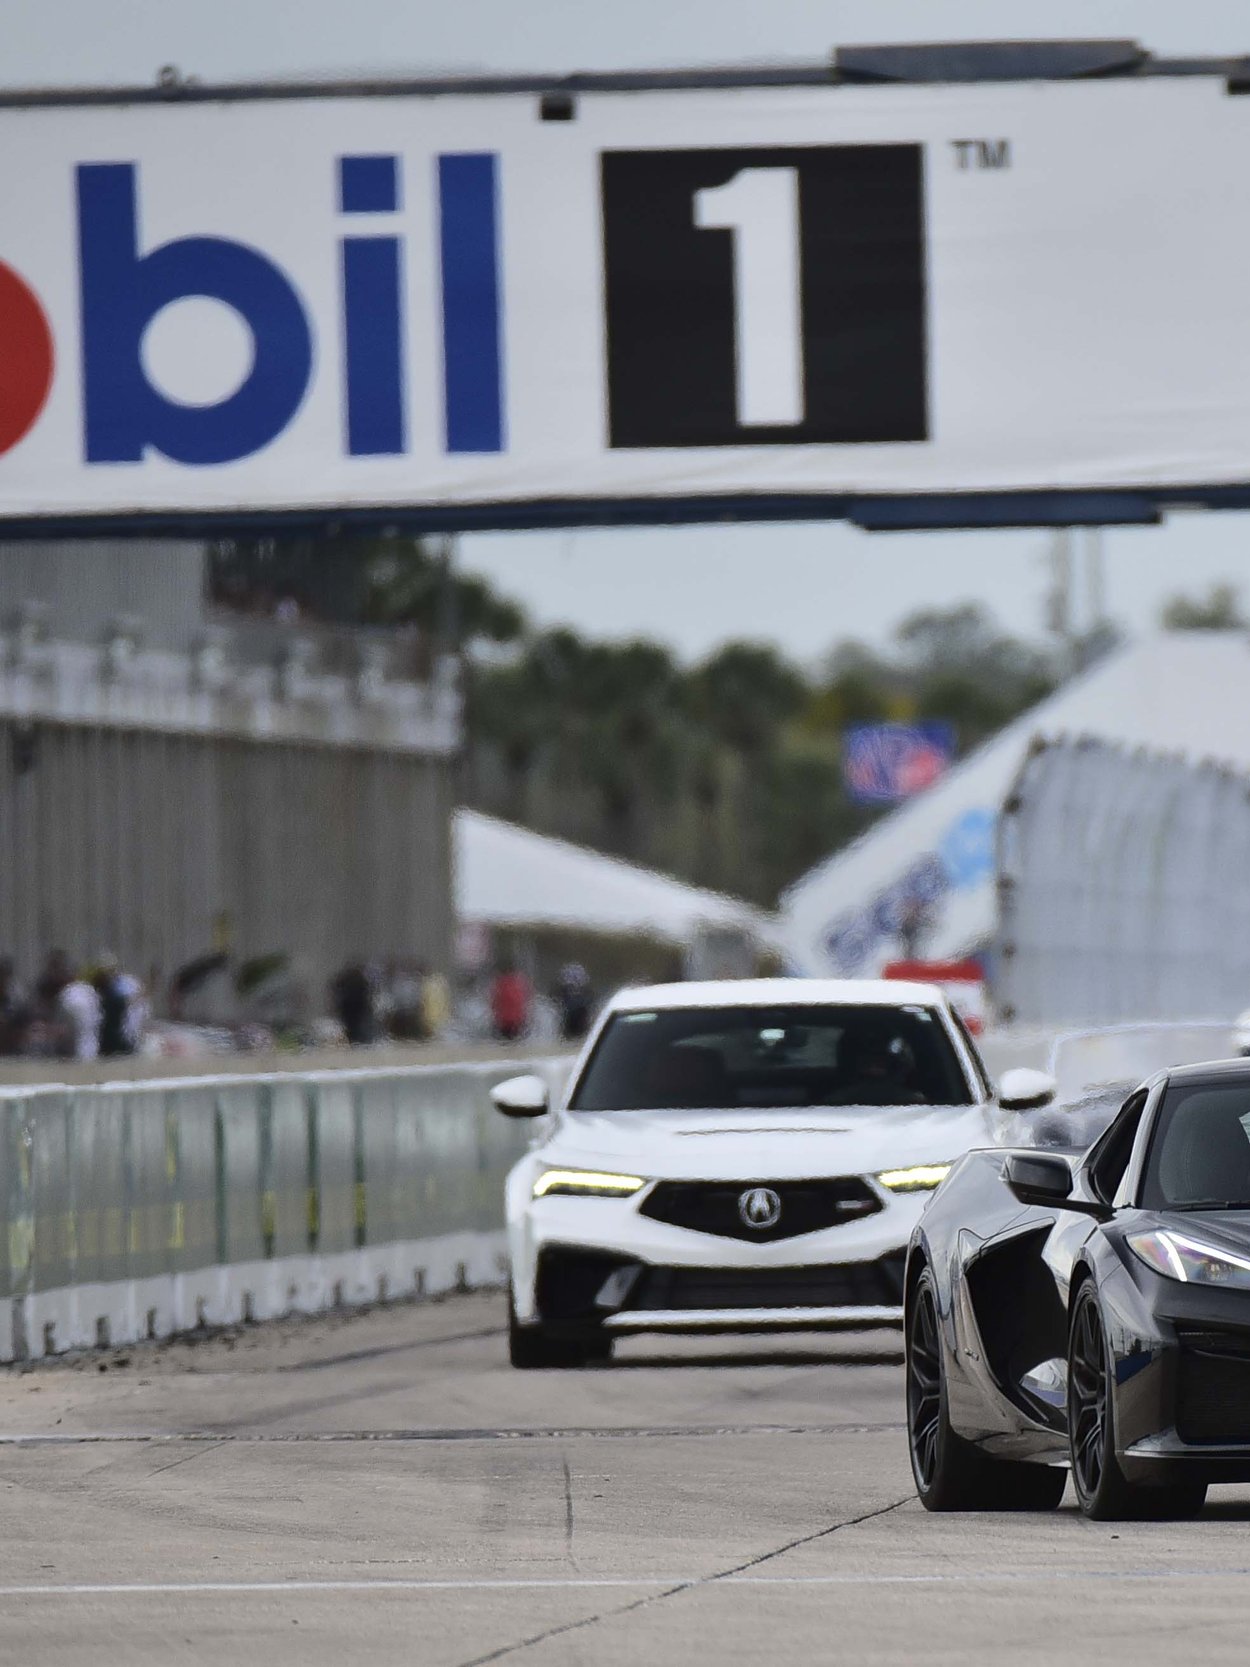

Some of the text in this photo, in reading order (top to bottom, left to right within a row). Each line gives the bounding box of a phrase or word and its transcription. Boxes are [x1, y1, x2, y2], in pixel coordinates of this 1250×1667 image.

[0, 139, 1010, 467] bil 1 TM
